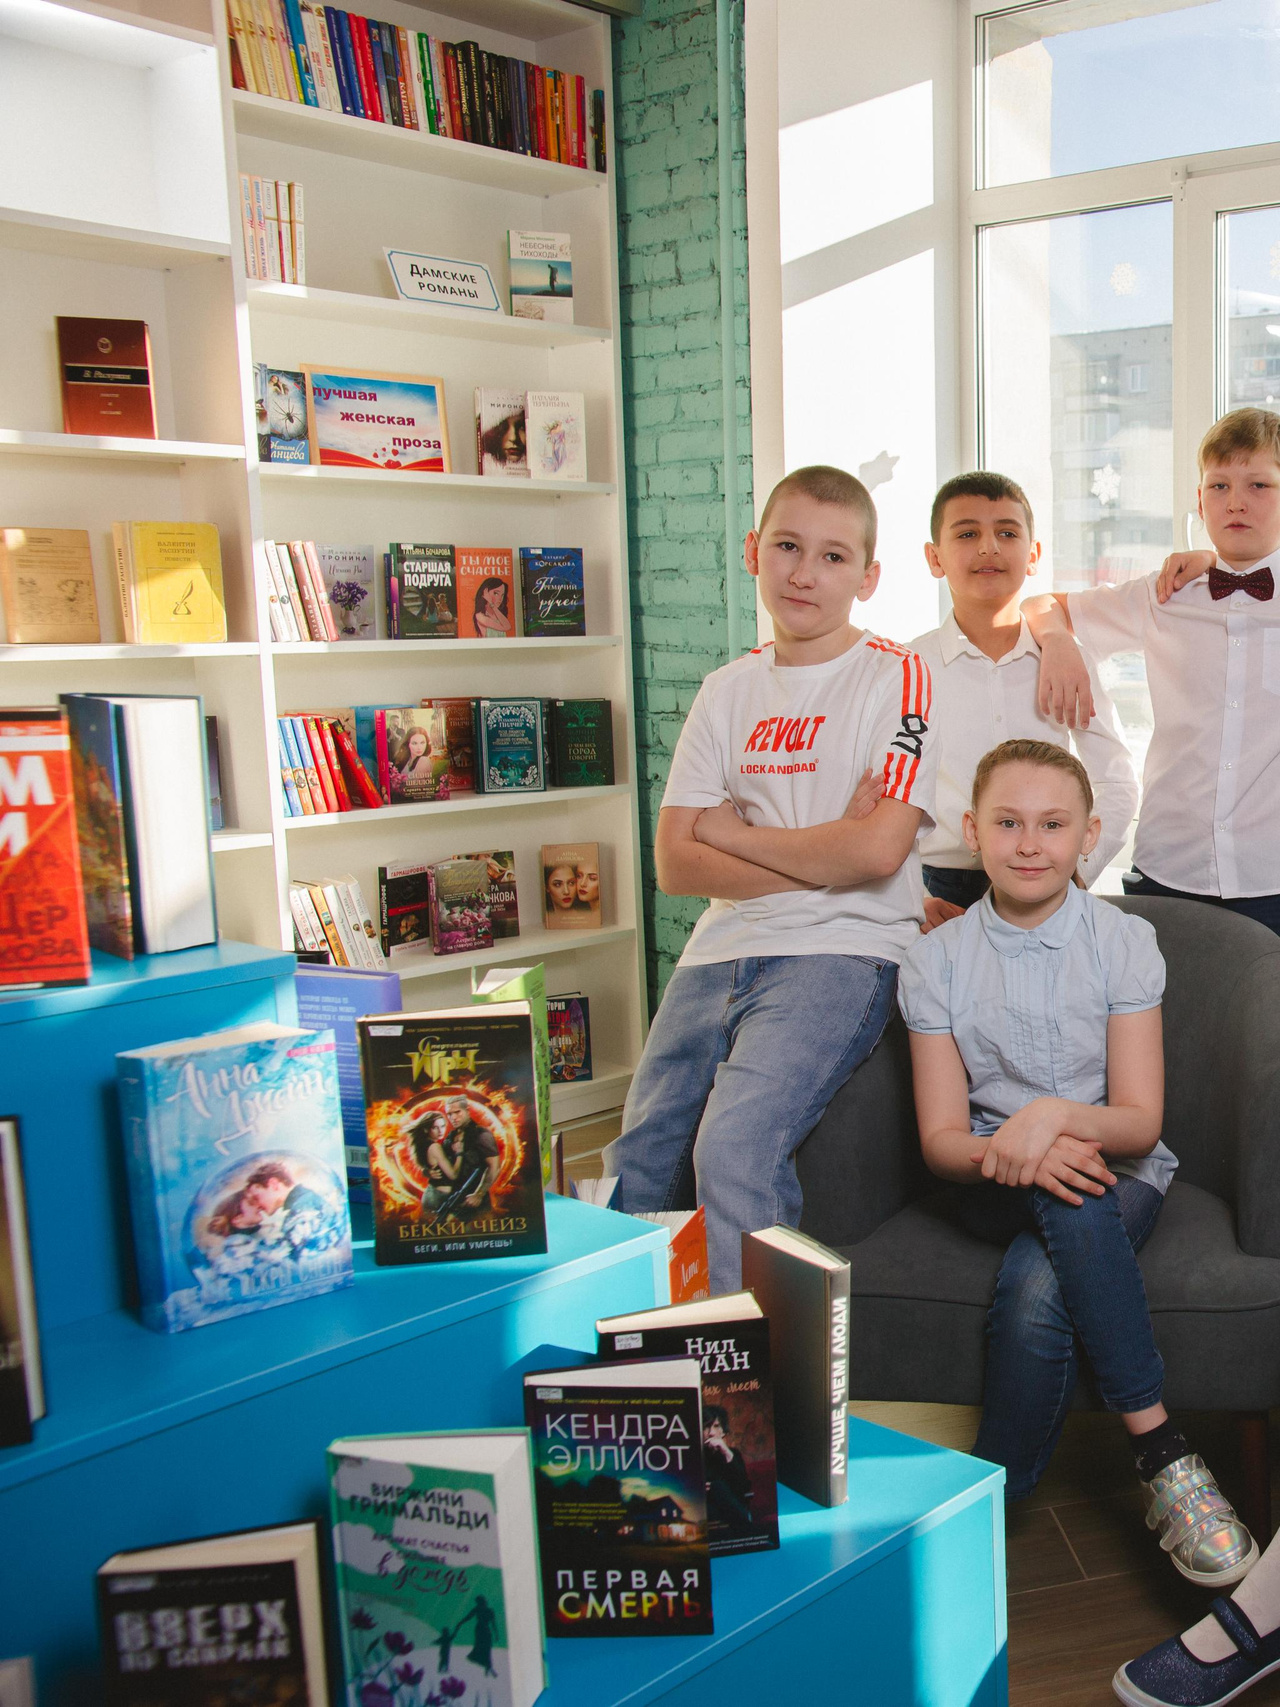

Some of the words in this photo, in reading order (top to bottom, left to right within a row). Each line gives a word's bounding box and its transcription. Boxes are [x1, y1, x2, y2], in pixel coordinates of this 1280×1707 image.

[519, 242, 557, 250] НЕБЕСНЫЕ
[520, 250, 558, 259] ТИХОХОДЫ
[409, 263, 478, 285] ДАМСКИЕ
[418, 281, 479, 299] РОМАНЫ
[312, 386, 378, 402] лучшая
[489, 402, 525, 410] МИРОНО
[340, 411, 416, 427] женская
[271, 442, 306, 460] лнцева
[392, 436, 442, 450] проза
[157, 540, 197, 548] ВАЛЕНТИН
[403, 561, 451, 574] СТАРШАЯ
[460, 555, 480, 566] ТЫ
[482, 555, 511, 566] МОЕ
[535, 560, 576, 568] КОРСАКОВА
[460, 566, 511, 576] СЧАСТЬЕ
[404, 573, 452, 589] ПОДРУГА
[744, 716, 827, 754] REVOLT
[568, 747, 597, 755] ГОРОД
[547, 1001, 566, 1011] ТОРИЯ
[404, 1048, 480, 1084] ИГРЫ
[165, 1061, 262, 1119] Анна
[399, 1221, 466, 1239] БЕККИ
[473, 1217, 527, 1233] ЧЕЙЗ
[445, 1242, 466, 1252] ИЛИ
[468, 1239, 514, 1250] УМРЕШЬ!
[831, 1296, 849, 1356] ЛЮДИ
[685, 1337, 737, 1356] Нил
[831, 1358, 848, 1402] ЧЕМ
[545, 1413, 690, 1446] КЕНДРА
[547, 1445, 690, 1471] ЭЛЛИОТ
[370, 1482, 465, 1508] ВИРЖИНИ
[349, 1494, 490, 1531] ГРИМАЛЬДИ
[372, 1532, 418, 1548] АРОМАТ
[419, 1538, 471, 1554] СЧАСТЬЯ
[557, 1569, 699, 1590] ПЕРВАЯ
[558, 1591, 699, 1620] СМЕРТЬ
[113, 1600, 288, 1652] ВВЕРХ
